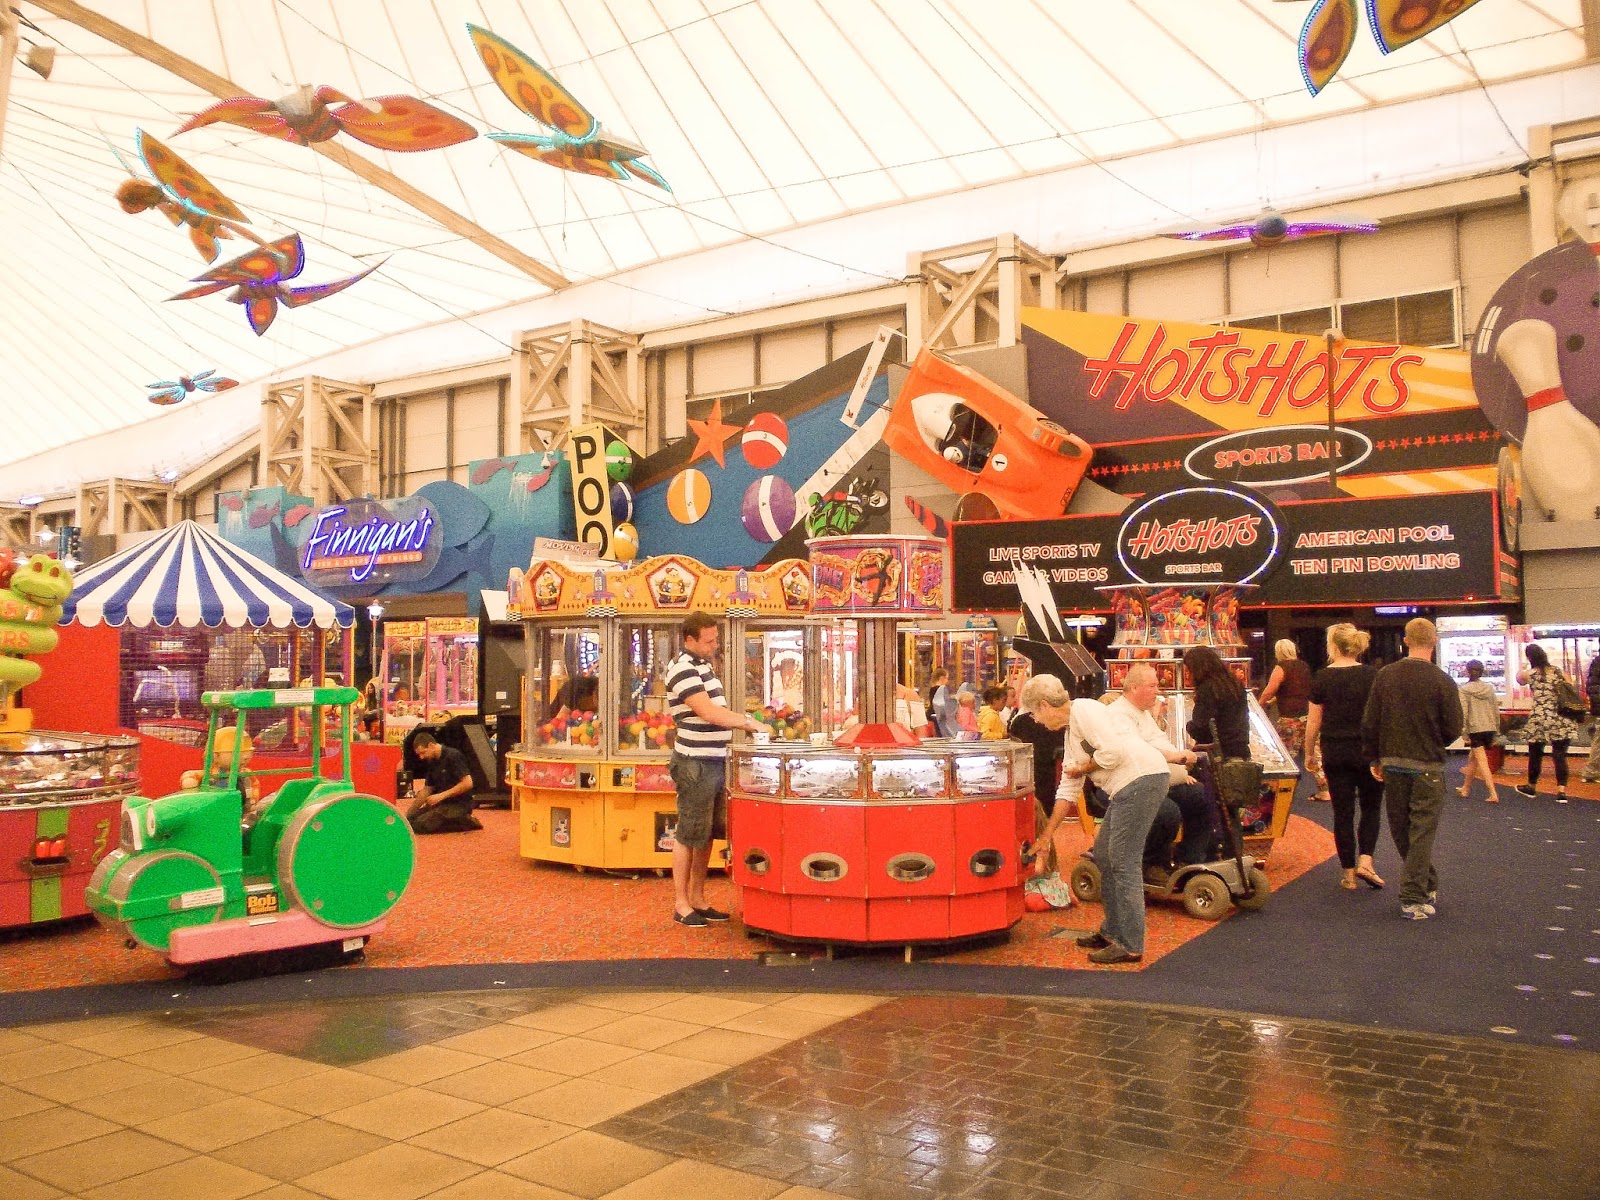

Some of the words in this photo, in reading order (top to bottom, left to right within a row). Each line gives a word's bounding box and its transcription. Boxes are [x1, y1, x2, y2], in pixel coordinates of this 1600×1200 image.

[1214, 445, 1292, 469] SPORTS
[1297, 440, 1342, 461] BAR
[303, 507, 434, 582] Finnigan's
[1295, 528, 1394, 548] AMERICAN
[1399, 525, 1455, 543] POOL
[542, 541, 580, 551] MOVING
[989, 547, 1020, 561] LIVE
[1022, 544, 1077, 560] SPORTS
[1079, 543, 1101, 557] TV
[1165, 564, 1200, 575] SPORTS
[1201, 563, 1223, 573] BAR
[1291, 558, 1327, 574] TEN
[1331, 557, 1363, 573] PIN
[1367, 553, 1460, 571] BOWLING
[1051, 568, 1108, 583] VIDEOS
[247, 894, 277, 907] Bob
